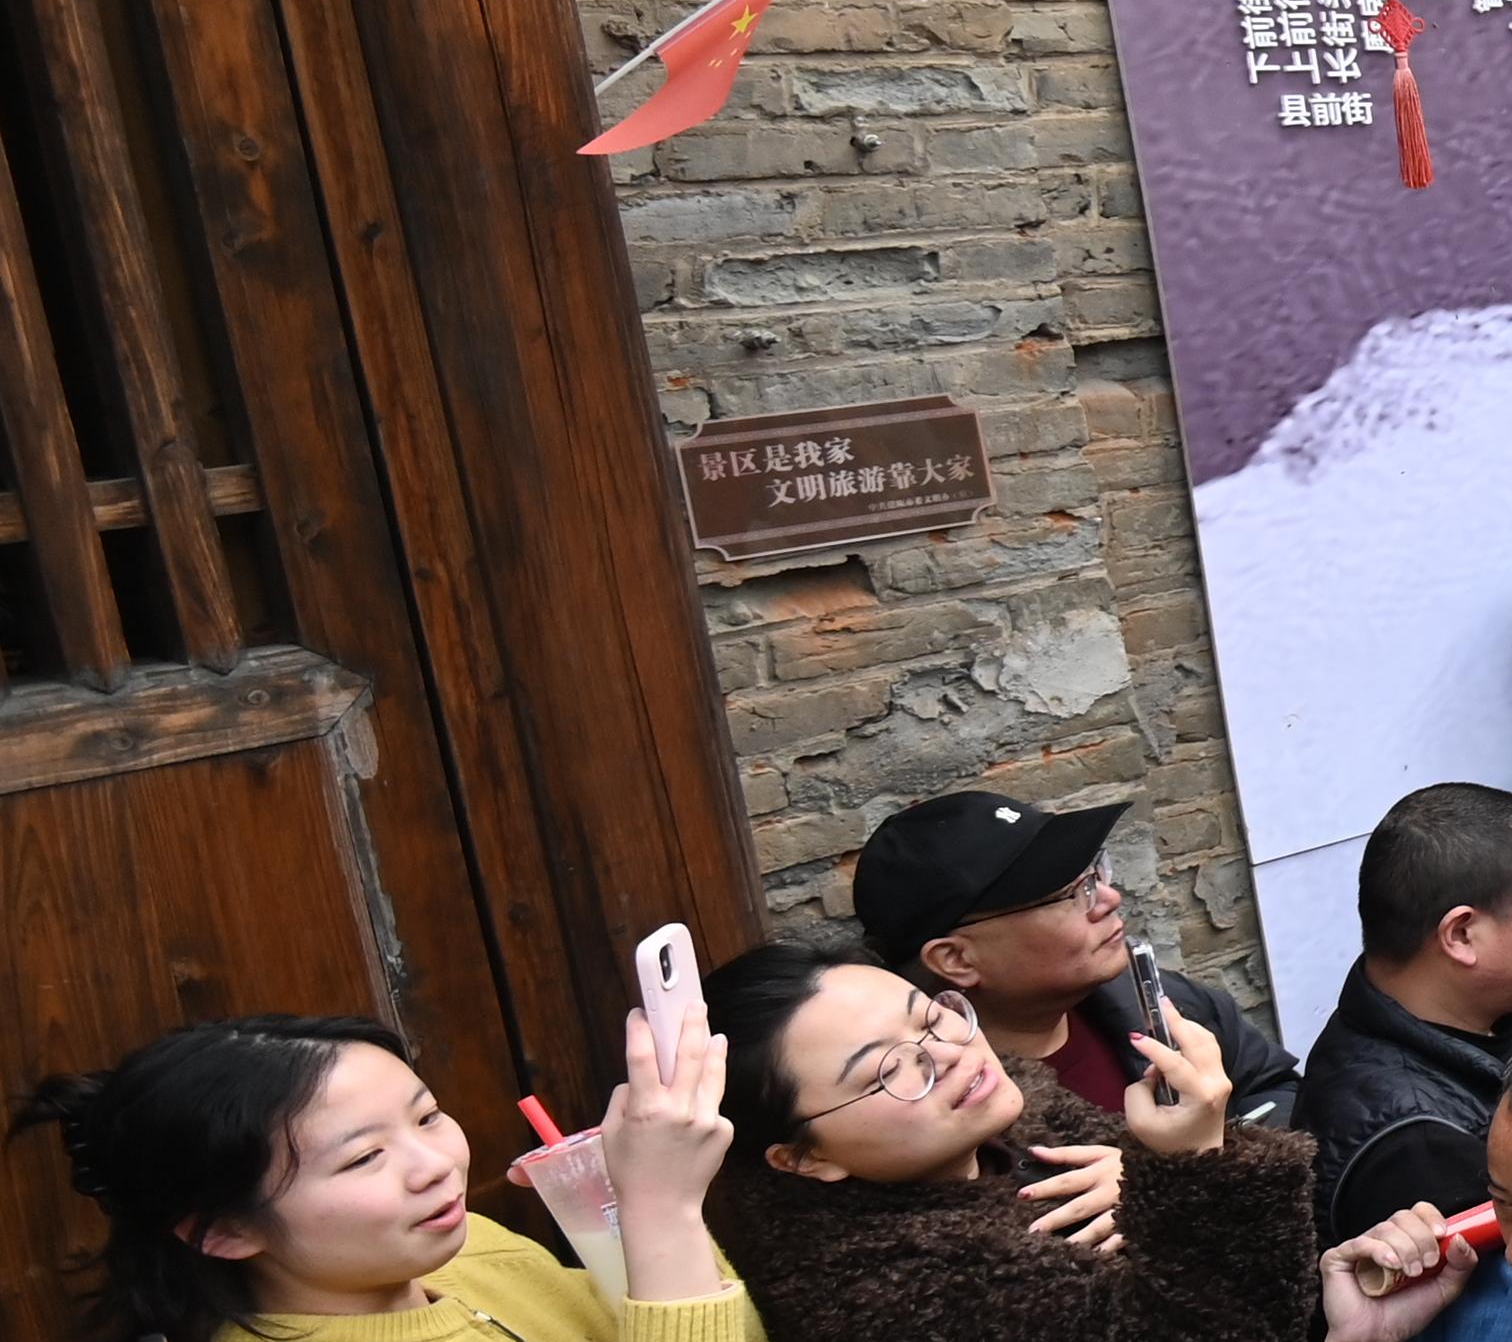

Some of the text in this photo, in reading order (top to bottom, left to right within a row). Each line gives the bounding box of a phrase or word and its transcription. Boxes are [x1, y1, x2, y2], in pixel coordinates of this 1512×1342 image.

[1278, 91, 1373, 127] 县前街
[699, 435, 855, 482] 景区是我家
[767, 454, 975, 509] 文明旅游靠大家
